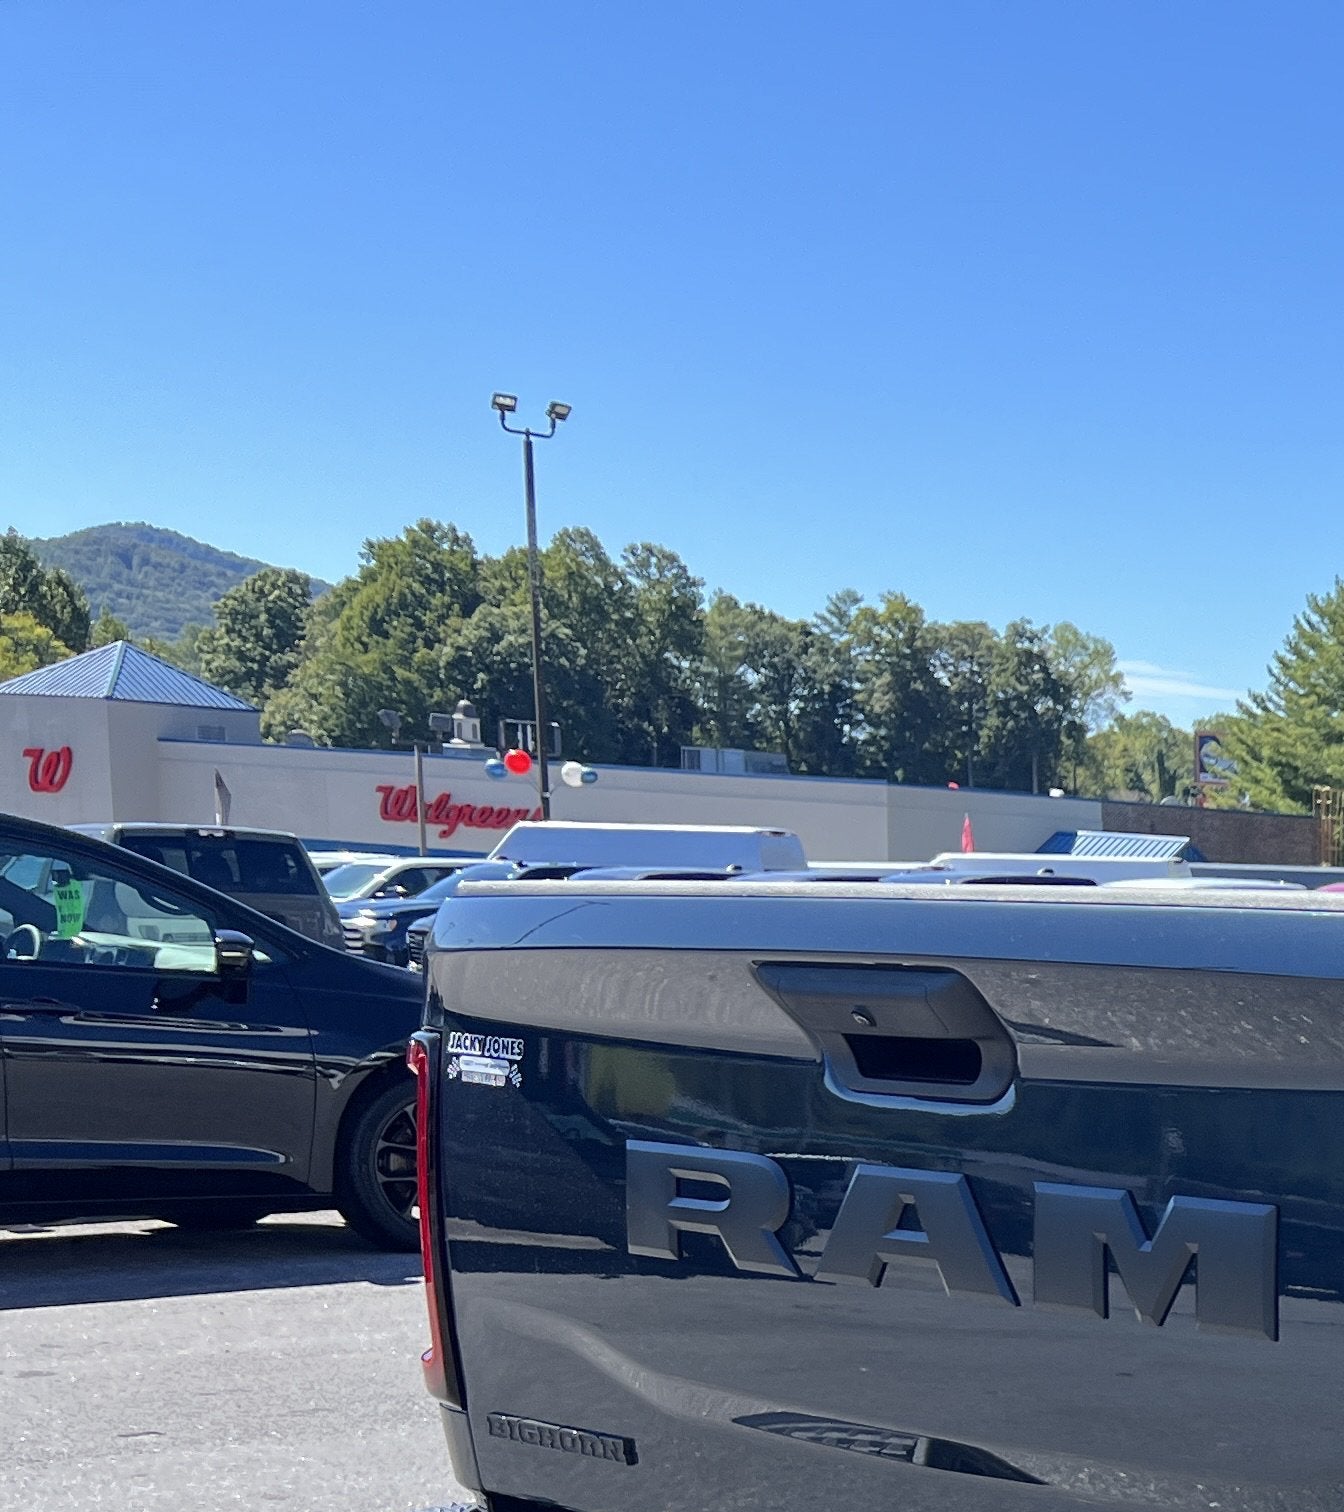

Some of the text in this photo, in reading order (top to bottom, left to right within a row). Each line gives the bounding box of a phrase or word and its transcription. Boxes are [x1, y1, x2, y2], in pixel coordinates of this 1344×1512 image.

[23, 746, 72, 793] W
[446, 1032, 524, 1060] JACKY JONES
[626, 1138, 1279, 1342] RAM
[486, 1411, 639, 1466] BIGHORN
